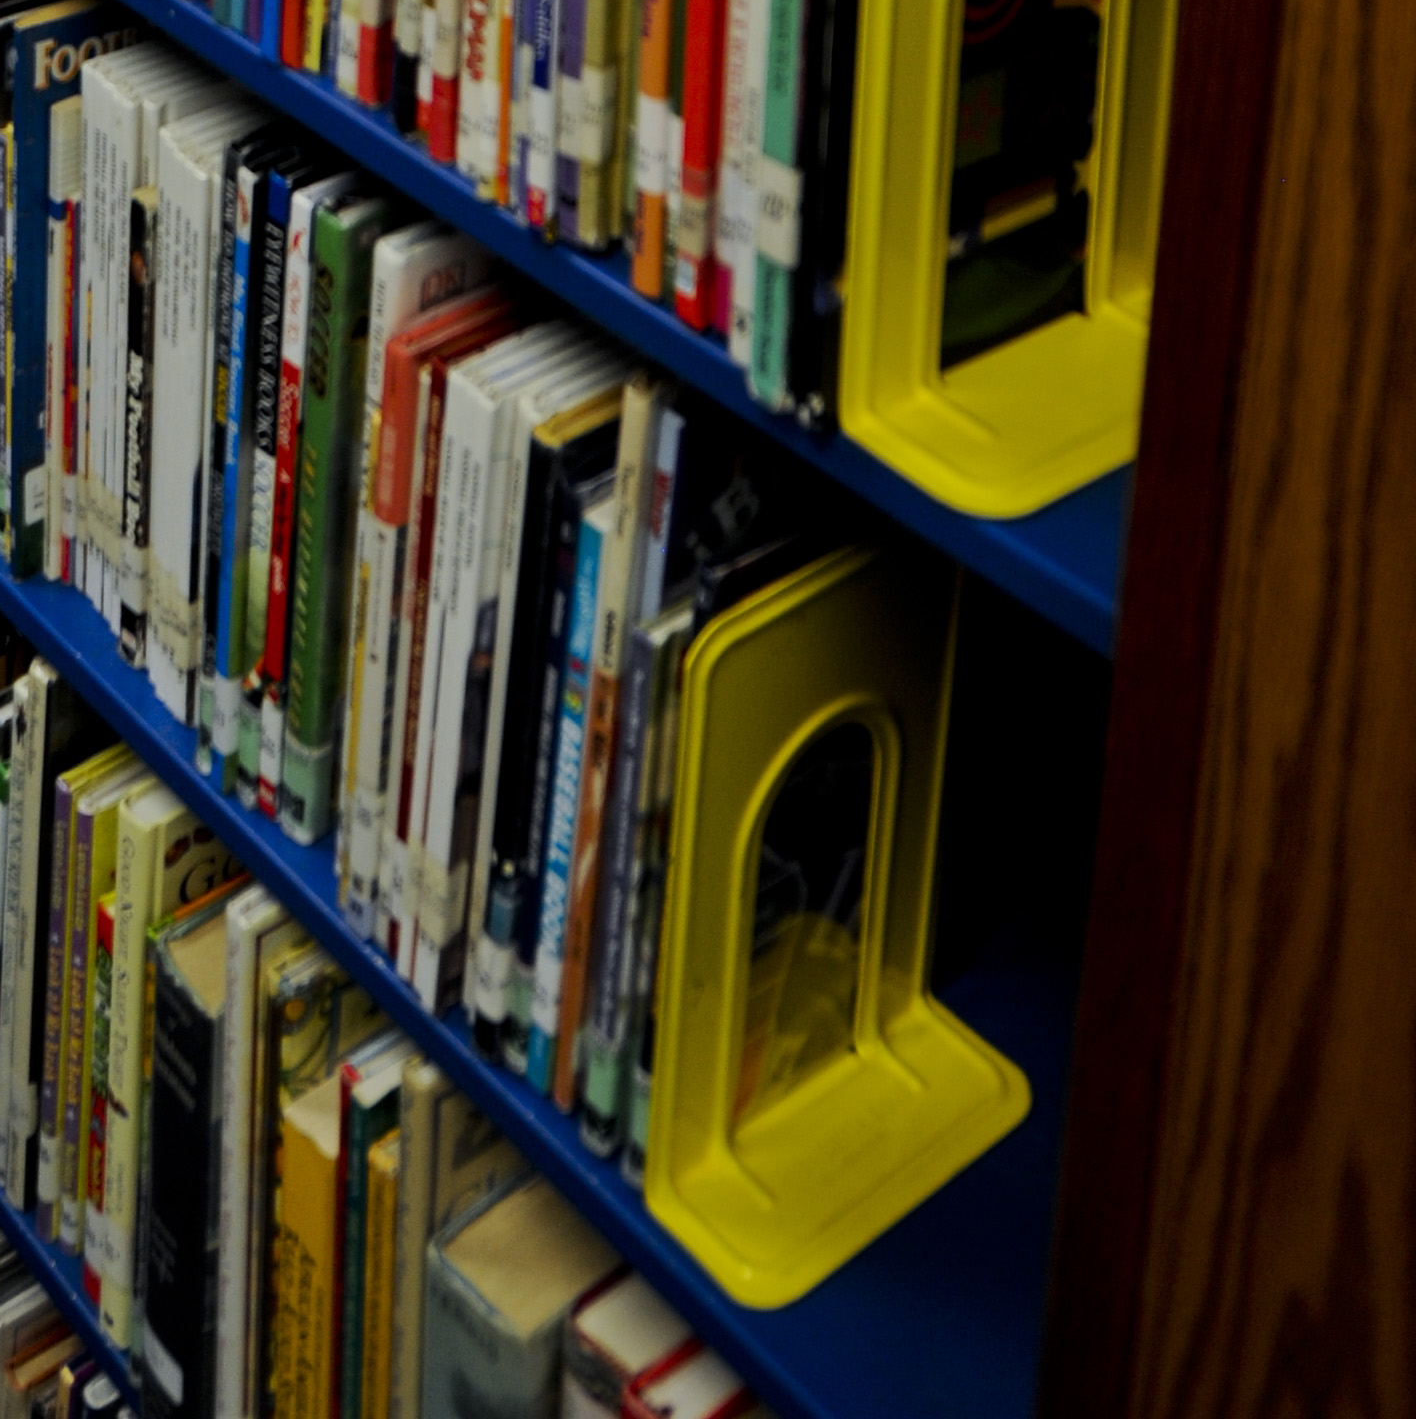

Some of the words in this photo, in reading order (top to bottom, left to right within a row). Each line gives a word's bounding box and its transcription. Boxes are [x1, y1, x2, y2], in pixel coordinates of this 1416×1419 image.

[232, 272, 247, 297] My
[259, 222, 285, 368] EYEWITNESS
[127, 351, 144, 386] My
[229, 308, 245, 351] First
[310, 265, 334, 402] SOCCER
[227, 355, 242, 414] Soccer
[256, 369, 280, 453] BOOKS
[277, 381, 299, 451] Soccer
[125, 393, 143, 493] Football
[225, 420, 240, 465] Book
[248, 457, 274, 551] SOCCER
[548, 714, 584, 865] BASEBALL
[538, 869, 567, 963] BOOK
